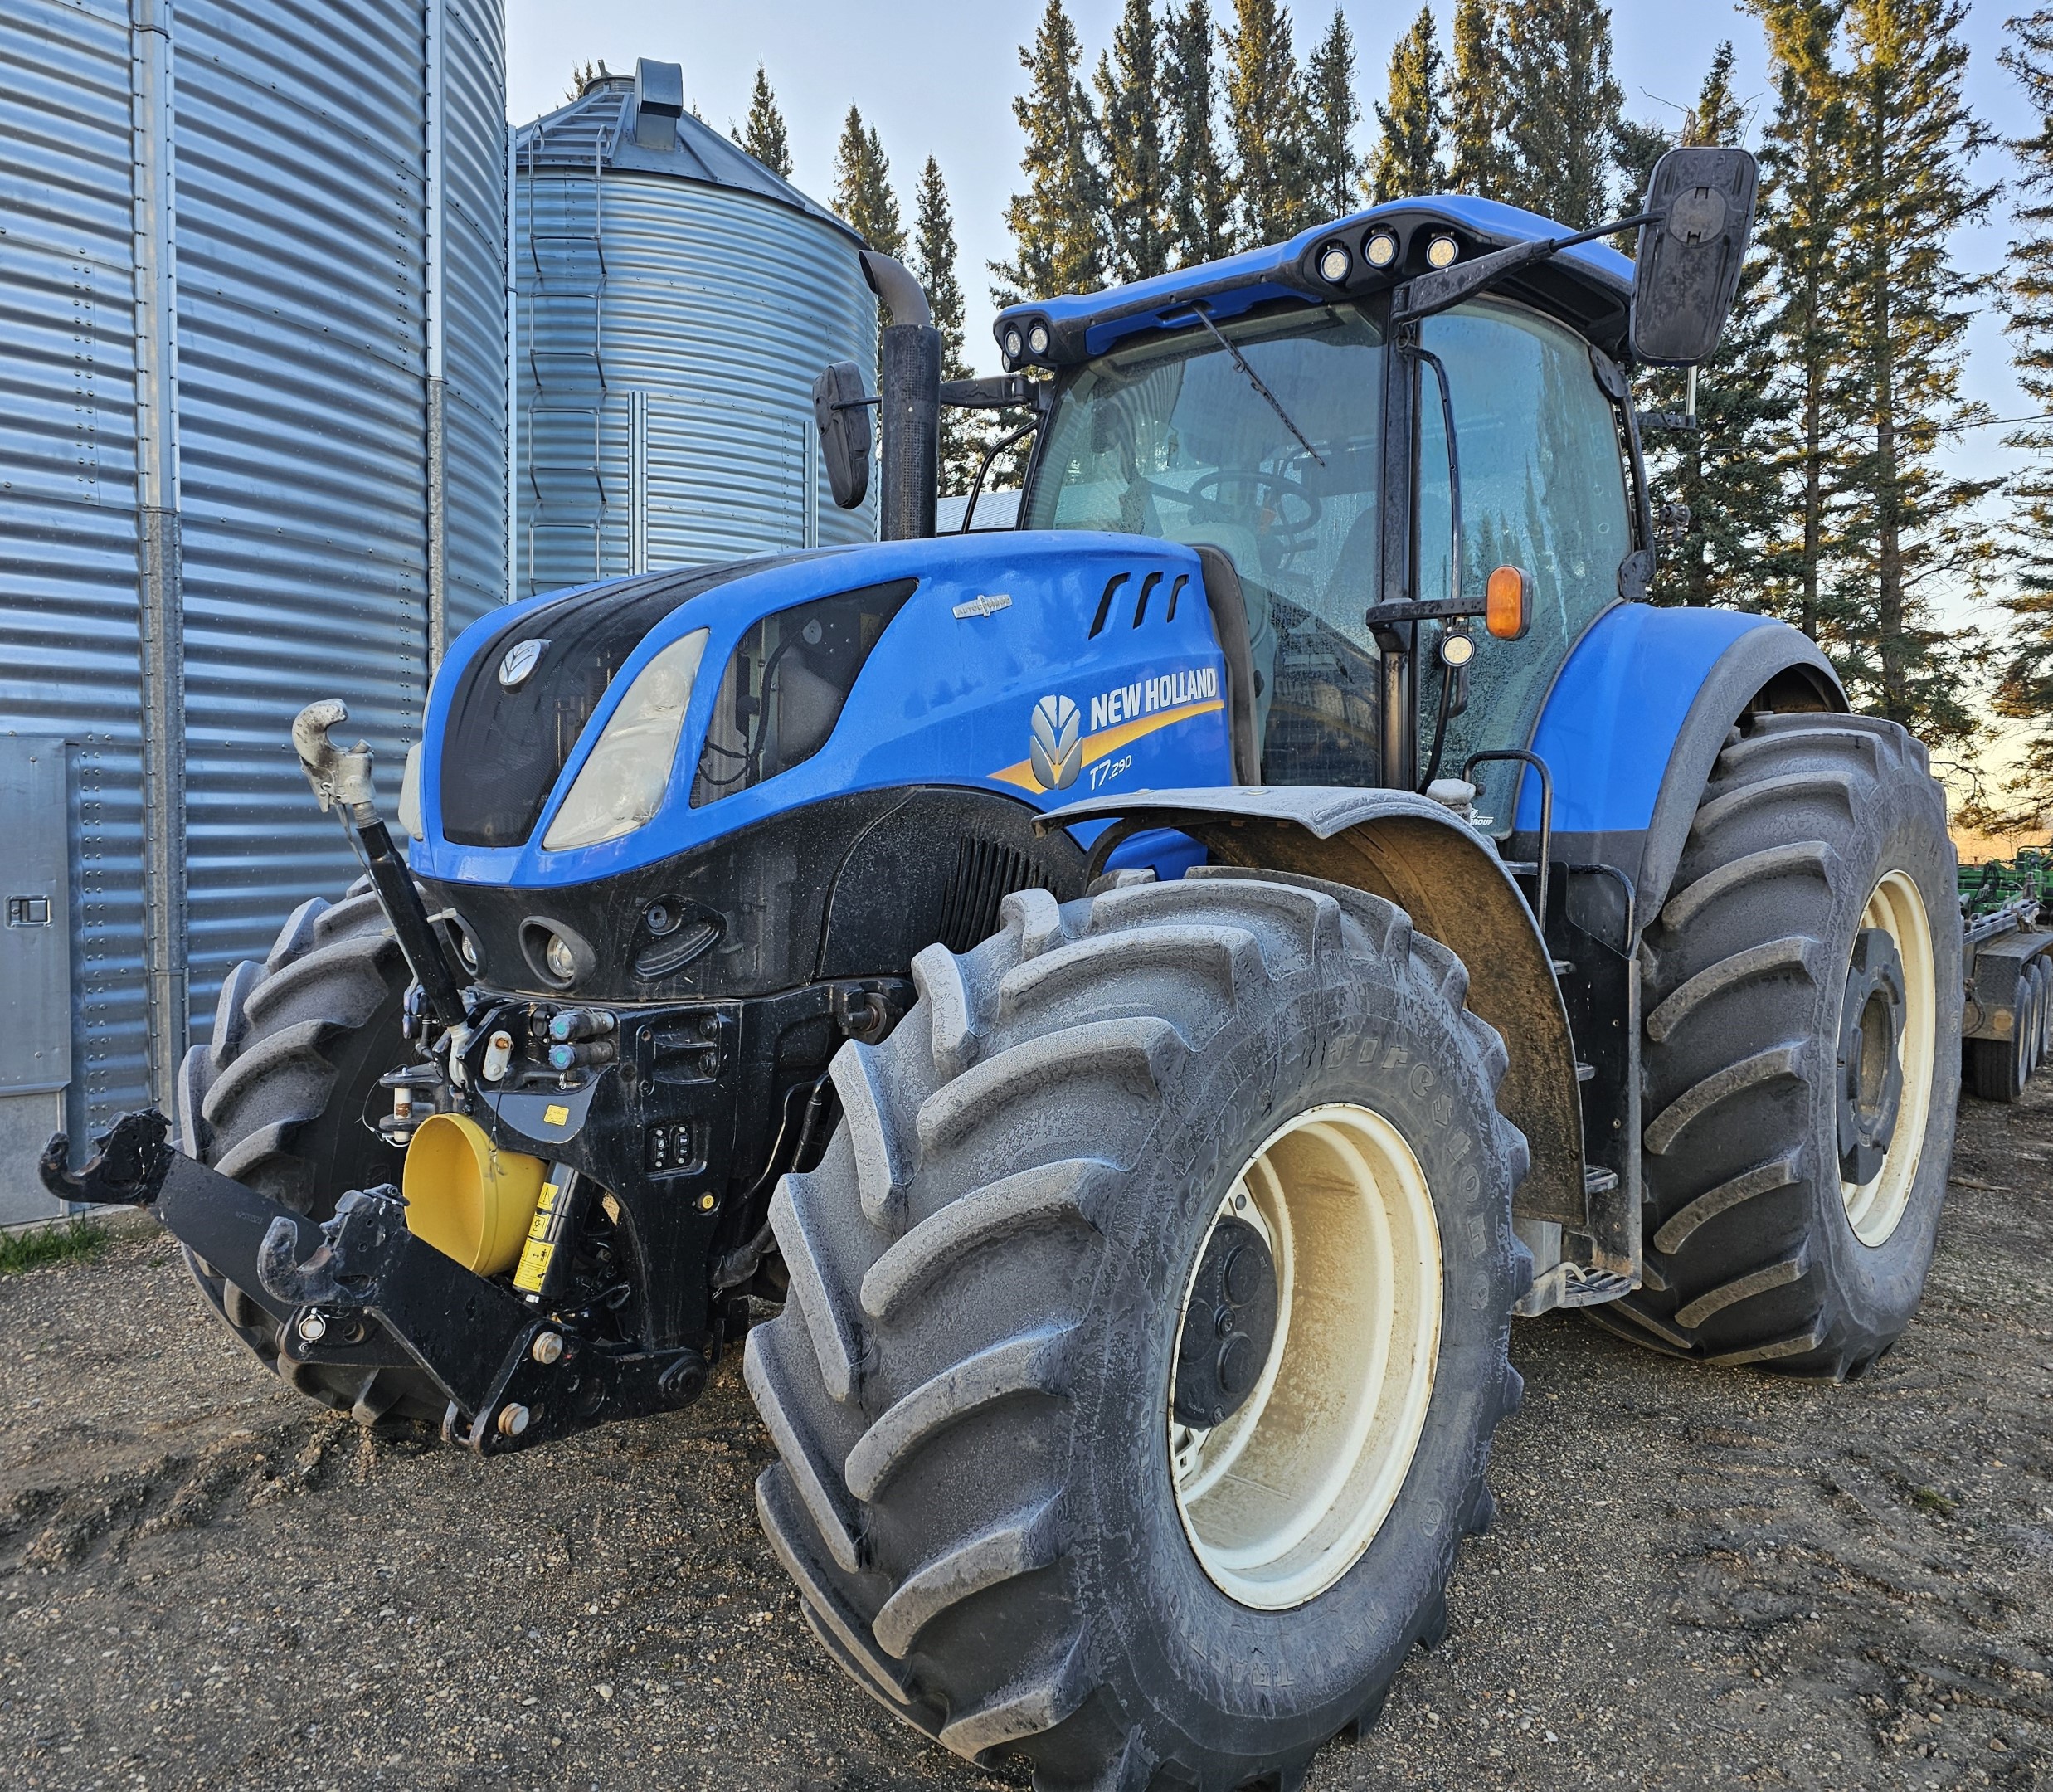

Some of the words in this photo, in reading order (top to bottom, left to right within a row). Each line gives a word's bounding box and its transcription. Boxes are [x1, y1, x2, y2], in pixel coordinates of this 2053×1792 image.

[1091, 682, 1141, 732] NEW
[1146, 667, 1218, 713] HOLLAND
[1090, 754, 1132, 791] T7.290
